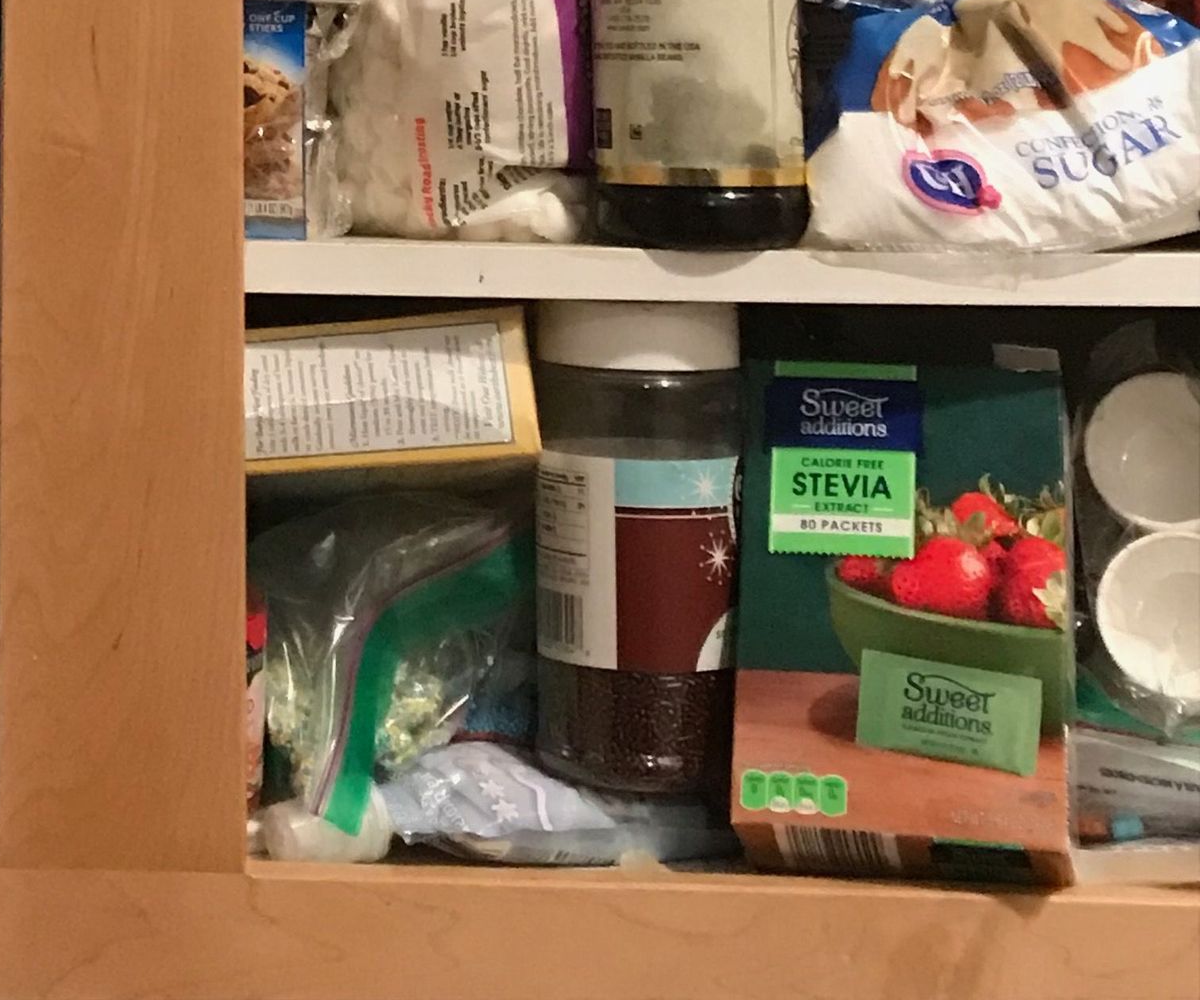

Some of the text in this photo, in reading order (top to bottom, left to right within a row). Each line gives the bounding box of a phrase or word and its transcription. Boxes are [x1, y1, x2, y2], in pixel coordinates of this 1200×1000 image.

[274, 11, 296, 23] CUP
[1031, 114, 1183, 190] SUGAR
[800, 387, 889, 418] Sweet
[800, 416, 889, 438] additions
[801, 457, 885, 470] CALORIE FREE
[792, 472, 892, 499] STEVIA
[815, 502, 870, 513] EXTRACT
[800, 520, 884, 533] 80 PACKETS
[903, 672, 996, 714] Sweet
[901, 703, 994, 737] additions
